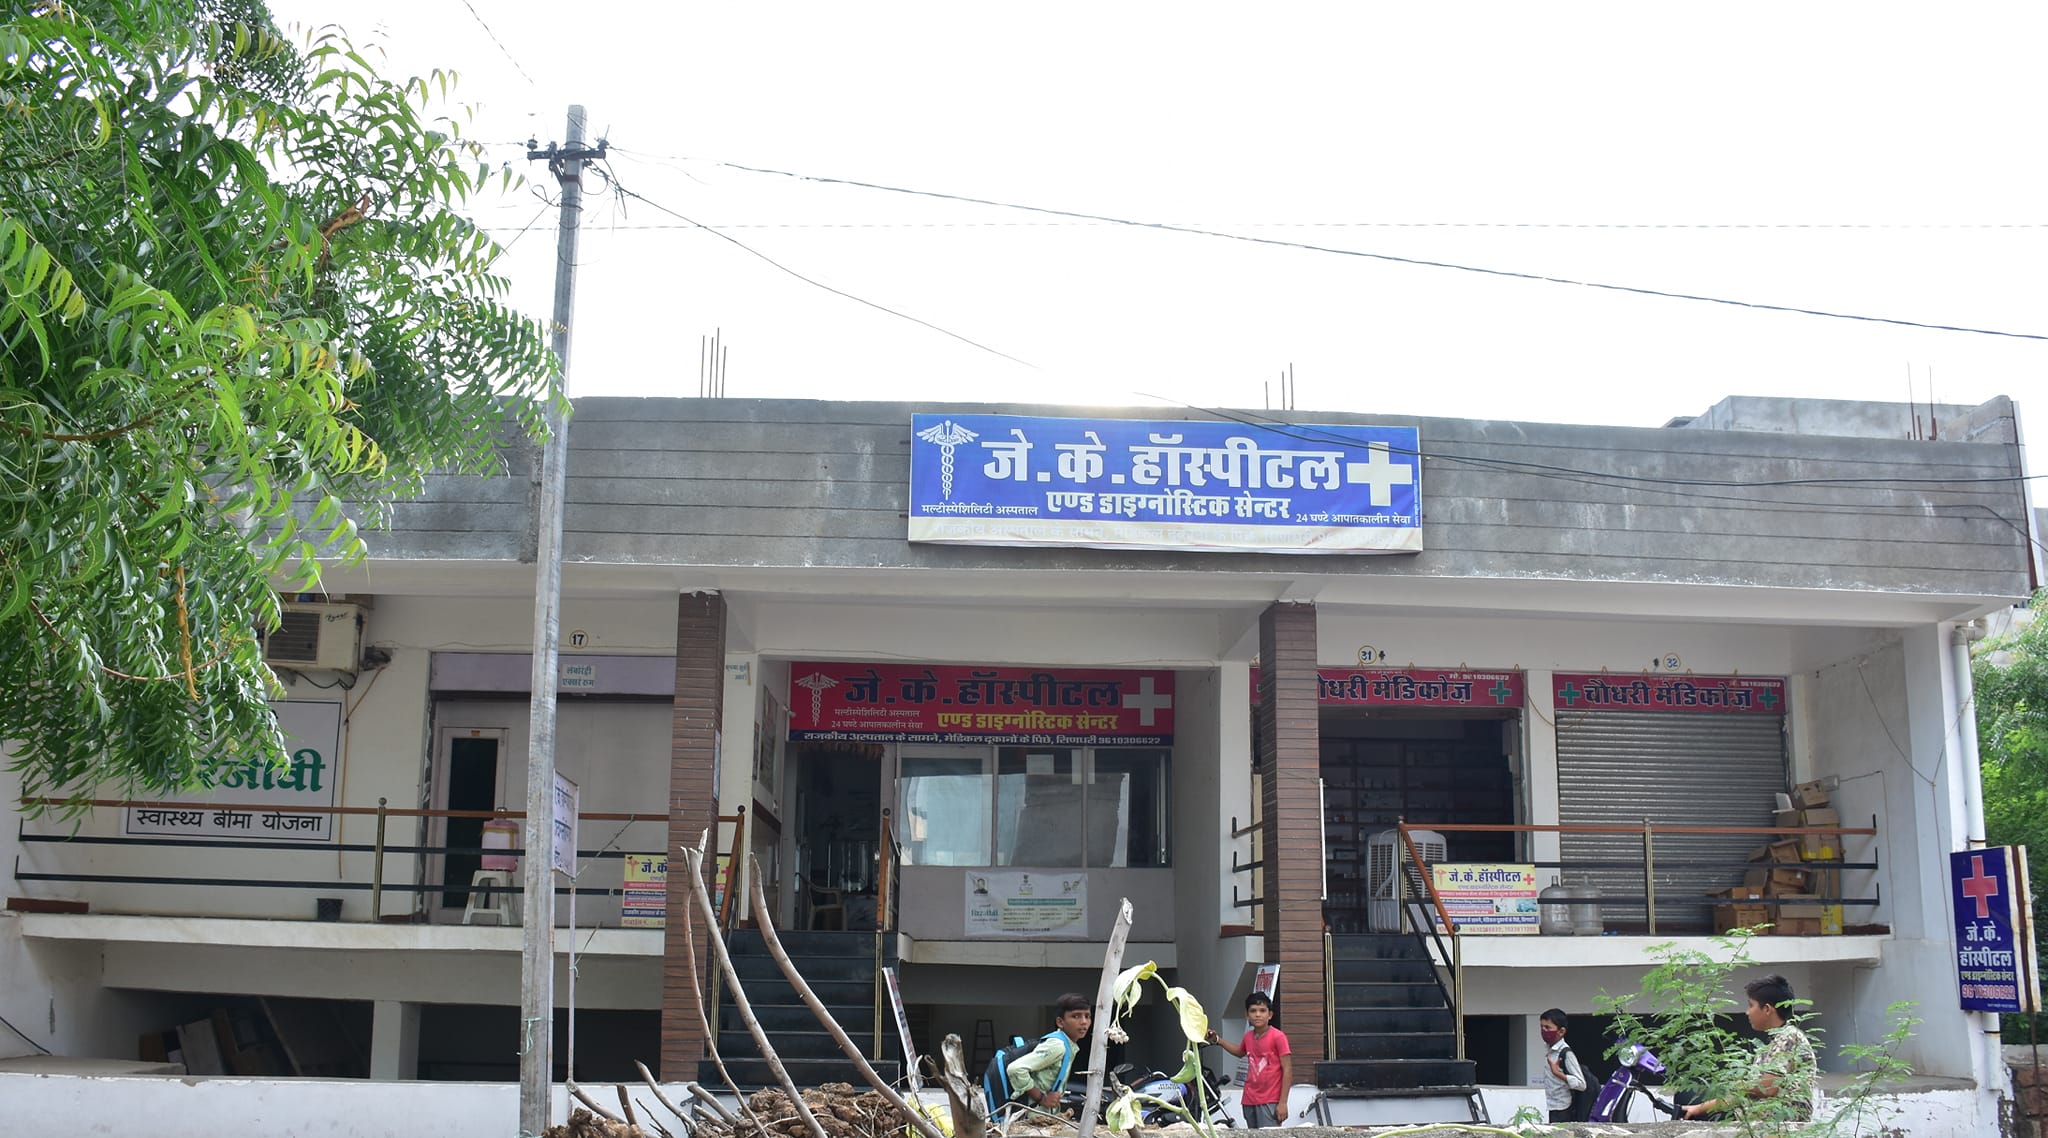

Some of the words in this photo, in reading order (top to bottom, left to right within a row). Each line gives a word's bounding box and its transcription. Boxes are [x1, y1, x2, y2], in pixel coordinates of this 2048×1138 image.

[996, 504, 1039, 516] अस्पताल
[1046, 491, 1095, 513] एण्ड
[1099, 488, 1231, 518] डाइग्नोस्टिक
[1234, 490, 1291, 519] सेन्टर
[1295, 513, 1308, 523] 24
[1310, 511, 1328, 523] घण्टे
[1331, 513, 1390, 525] आपातकालीन
[1392, 512, 1411, 524] सेवा
[572, 634, 585, 645] 17
[1666, 657, 1678, 668] 32
[1583, 680, 1651, 705] चौधरी
[831, 720, 841, 728] 24
[907, 719, 924, 729] सेवा
[936, 712, 973, 729] एण्ड
[976, 710, 1073, 730] डाइग्नोस्टिक
[1075, 710, 1120, 730] सेन्टर
[804, 731, 848, 741] राजकीय
[849, 732, 894, 742] अस्पताल
[896, 732, 906, 742] के
[1020, 734, 1031, 744] के
[137, 809, 204, 828] स्वास्थ्य
[213, 809, 252, 829] बीमा
[263, 811, 322, 832] योजना
[1959, 946, 2012, 966] हॉस्पीटल
